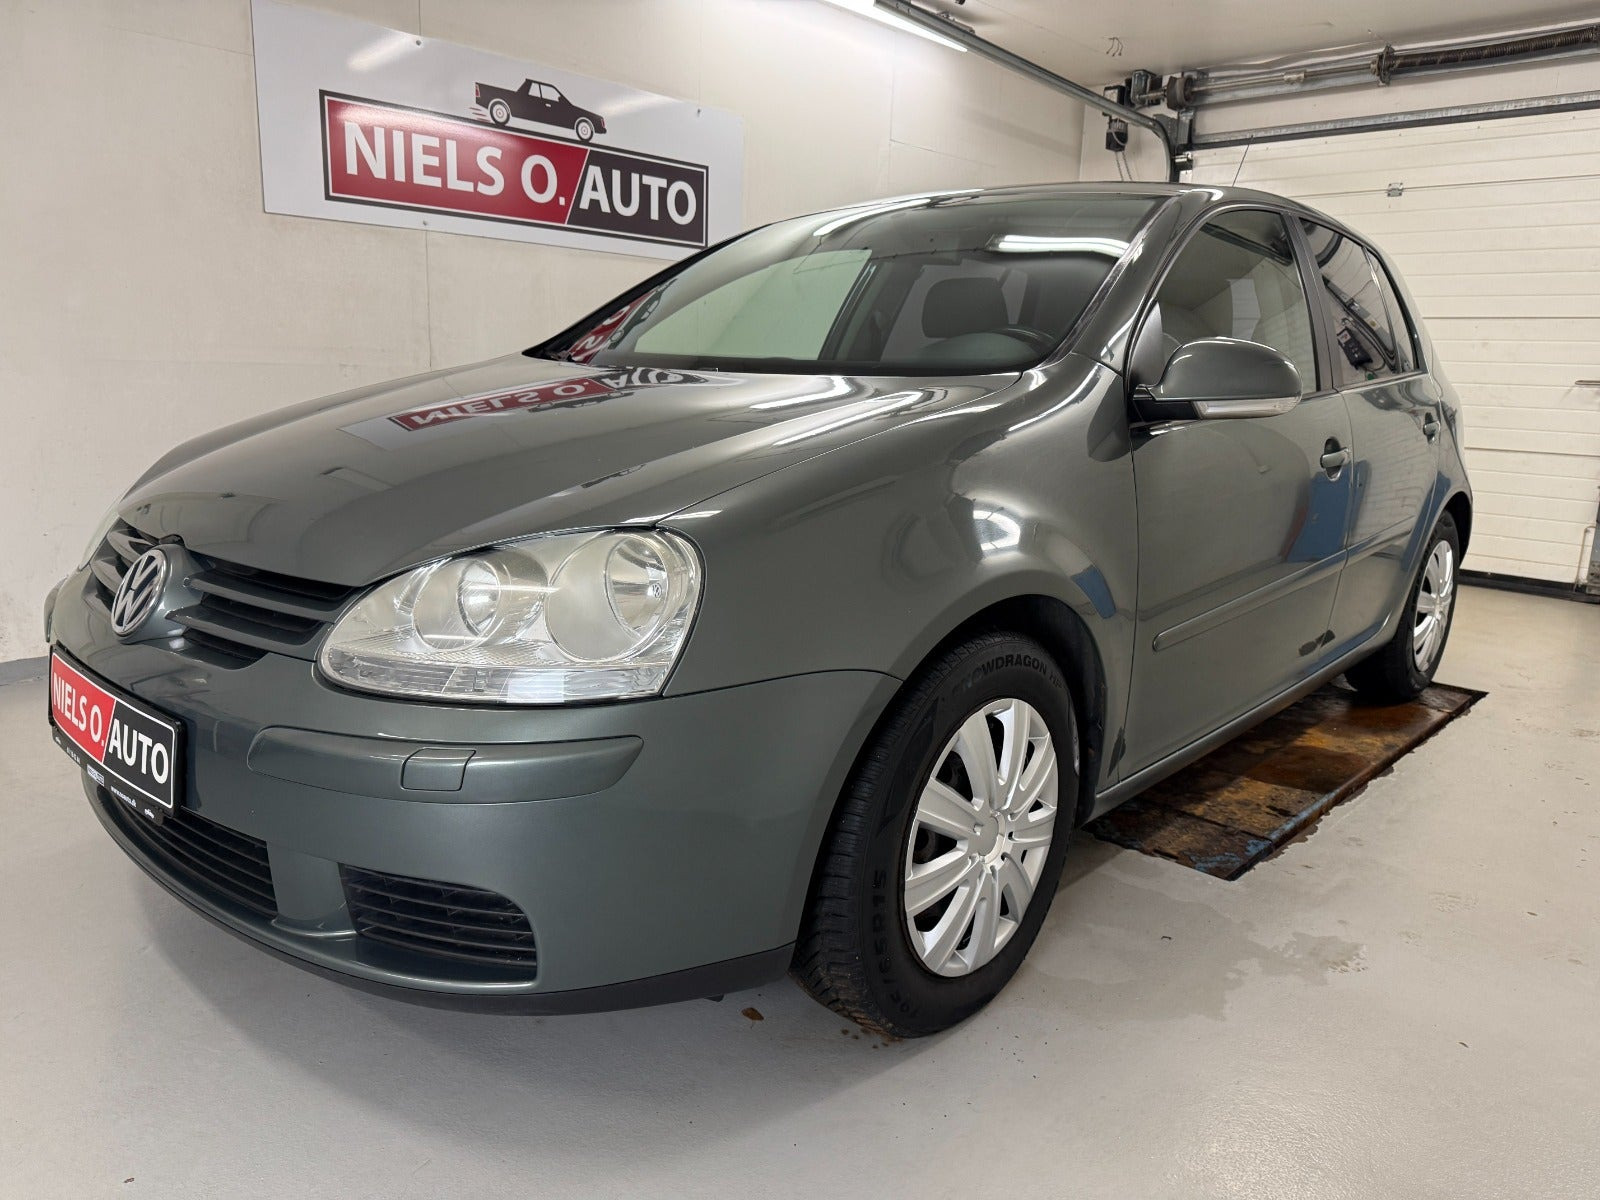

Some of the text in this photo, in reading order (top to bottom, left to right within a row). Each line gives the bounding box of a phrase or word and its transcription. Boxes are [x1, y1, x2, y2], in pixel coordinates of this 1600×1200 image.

[344, 121, 697, 225] NIELS O. AUTO
[53, 672, 169, 784] NIELS O. AUTO
